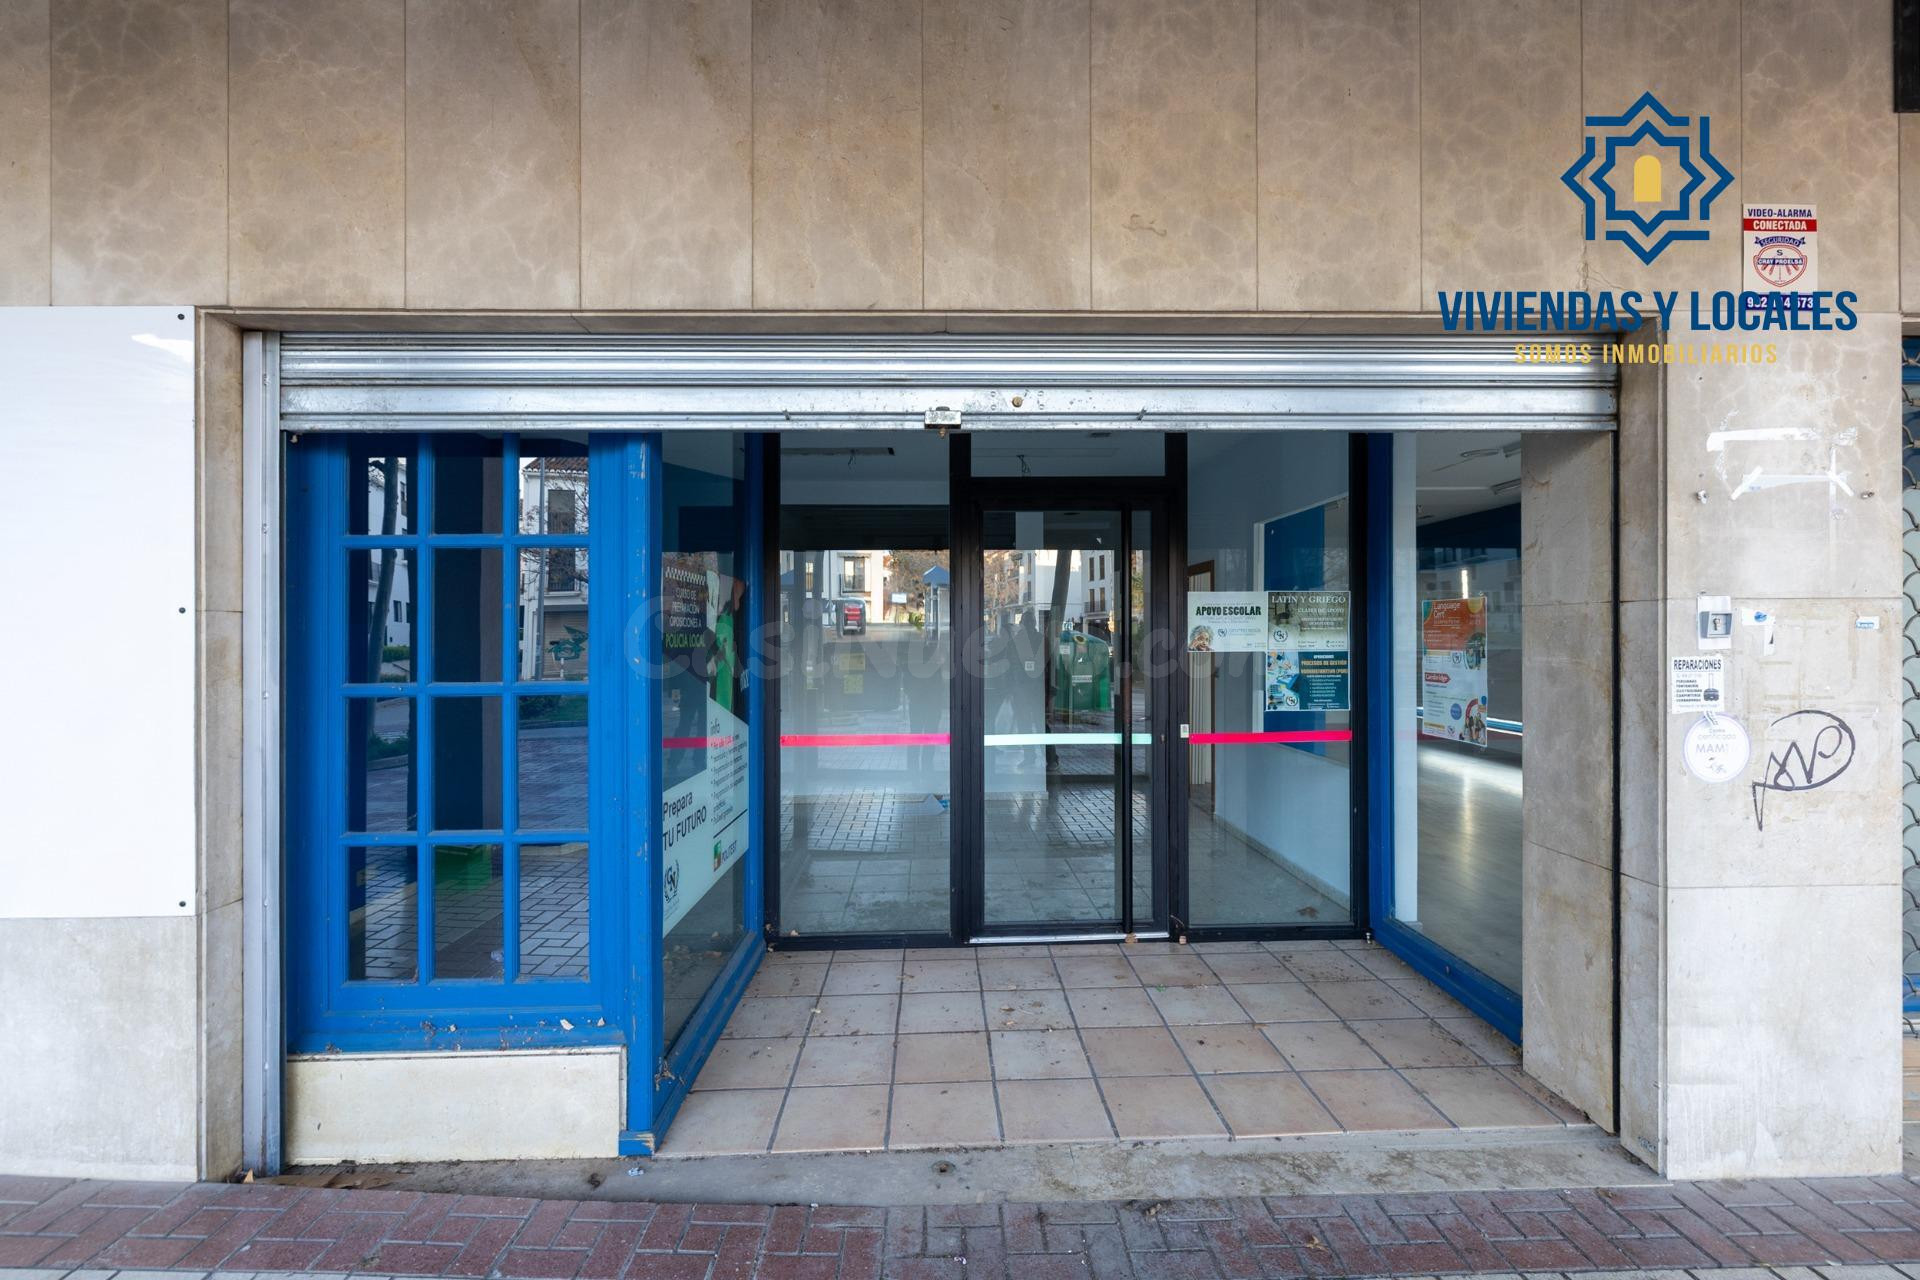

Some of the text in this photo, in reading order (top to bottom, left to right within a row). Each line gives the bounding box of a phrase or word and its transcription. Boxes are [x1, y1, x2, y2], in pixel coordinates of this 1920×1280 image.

[1747, 208, 1812, 218] VIDEO-ALARMA
[1753, 220, 1807, 230] CONECTADA
[1761, 236, 1800, 246] SEGURIDAD
[1300, 596, 1307, 604] Y
[1308, 595, 1346, 604] GRIEGO
[1195, 606, 1261, 616] APOYO ESCOLAR
[689, 633, 706, 648] LOCAL
[1673, 659, 1722, 670] REPARACIONES
[663, 791, 693, 821] Prepara
[662, 805, 707, 851] TU FUTURO
